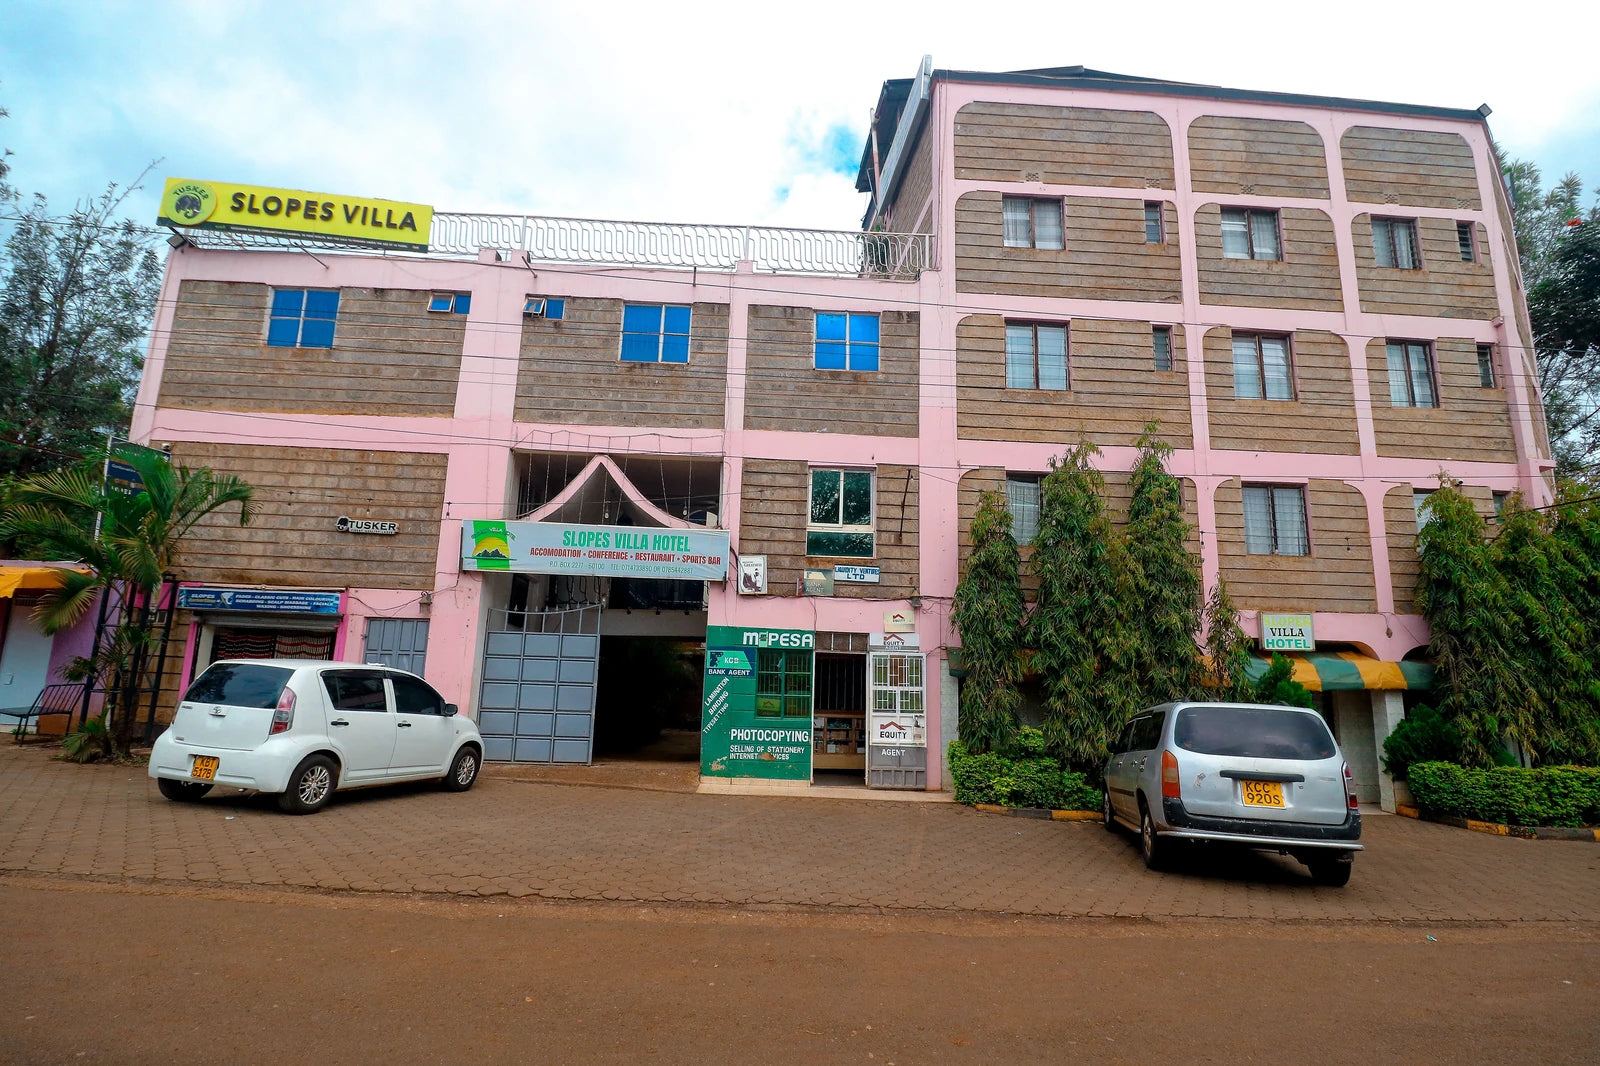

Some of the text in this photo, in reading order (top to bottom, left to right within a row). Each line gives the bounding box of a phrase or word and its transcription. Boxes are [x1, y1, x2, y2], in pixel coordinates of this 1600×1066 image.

[173, 185, 209, 200] TUSKER
[230, 191, 417, 232] SLOPES VILLA
[349, 520, 396, 530] TUSKER
[562, 530, 690, 552] SLOPES VILLA HOTEL
[530, 548, 721, 565] ACCOMODATION CONFERENCE RESTAURANT SPORTS BAR
[1264, 616, 1310, 627] SLOPES
[1270, 628, 1304, 636] VILLA
[1266, 638, 1310, 648] HOTEL
[704, 676, 730, 706] LAMINATION
[708, 690, 729, 715] BINDING
[730, 728, 809, 742] PHOTOCOPYING
[880, 731, 907, 739] EQUITY
[730, 744, 754, 752] SELLING
[767, 746, 805, 754] STATIONERY
[1246, 782, 1270, 793] KCC
[1246, 792, 1280, 804] 920S
